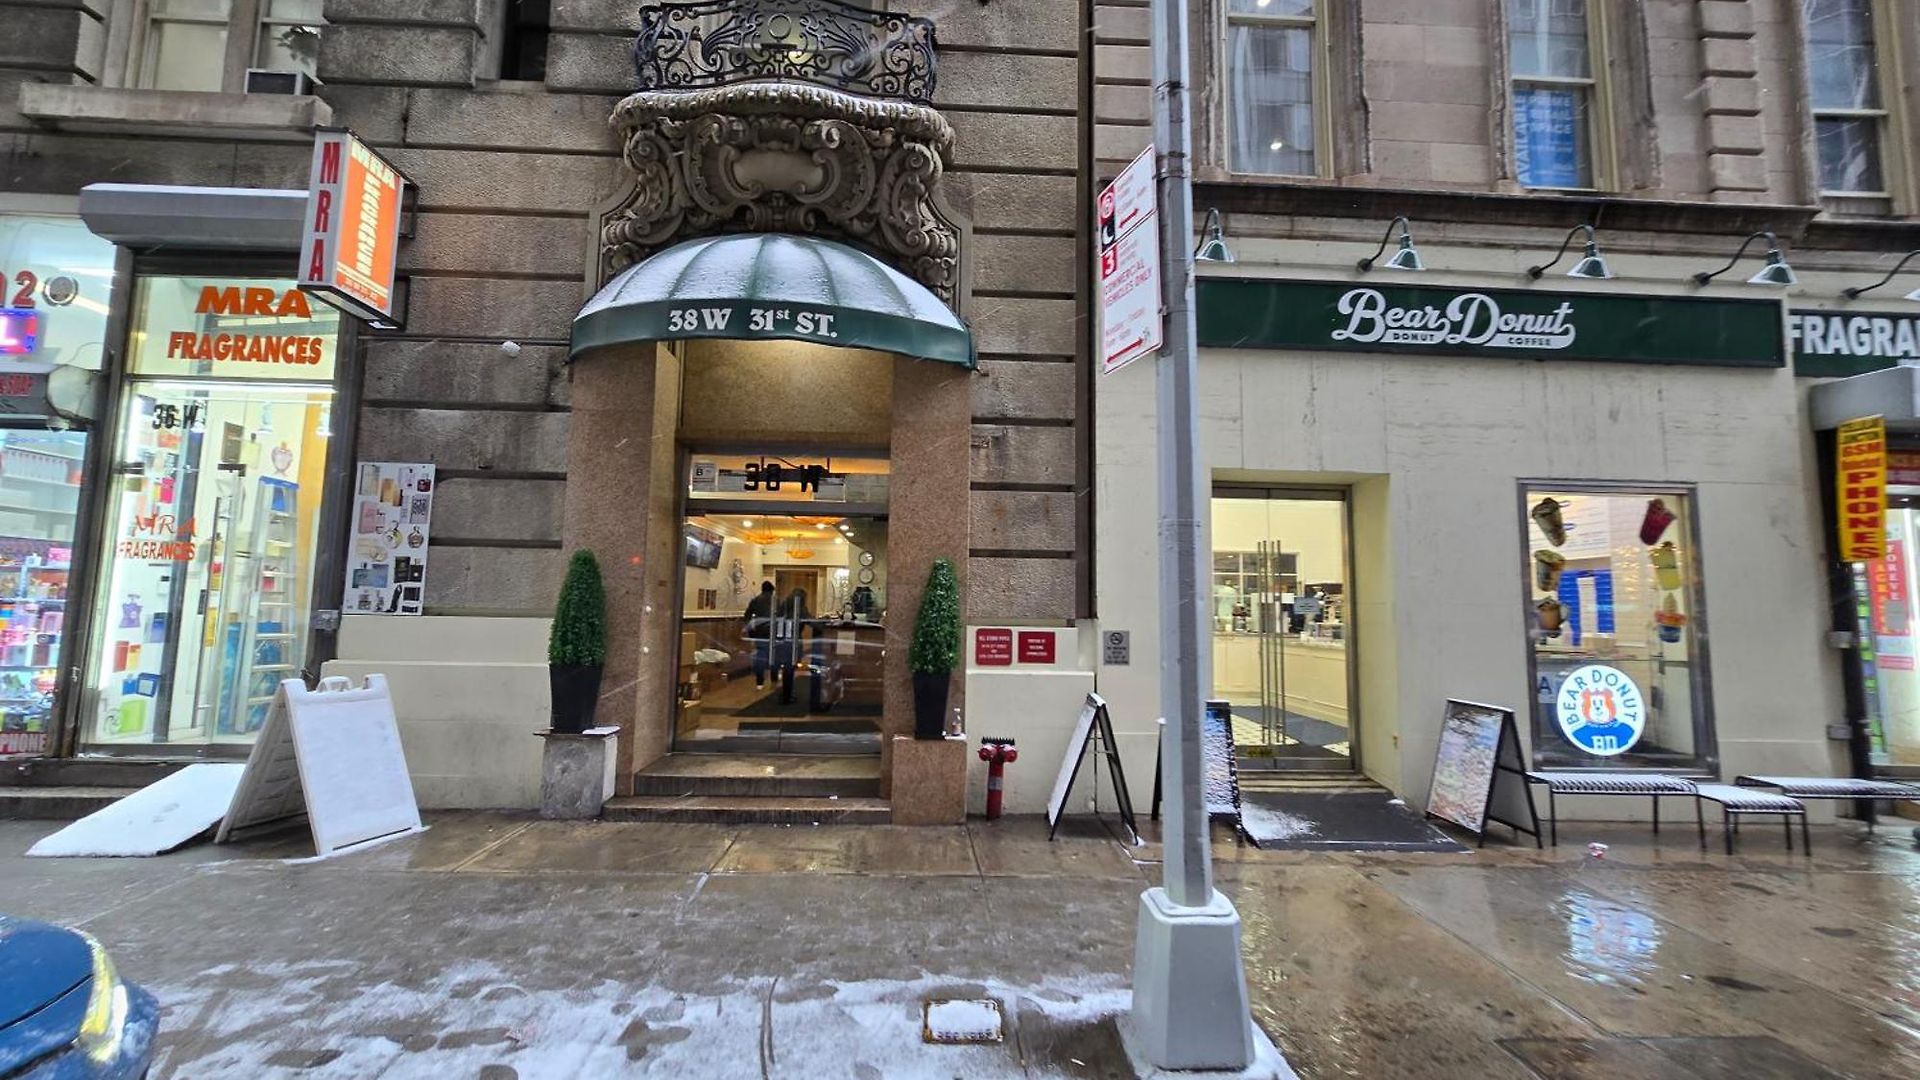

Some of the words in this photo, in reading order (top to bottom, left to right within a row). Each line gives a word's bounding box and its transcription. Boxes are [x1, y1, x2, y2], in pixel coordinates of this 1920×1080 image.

[308, 142, 340, 281] MRA
[1104, 249, 1114, 275] 3
[195, 286, 311, 318] MRA
[795, 311, 838, 338] ST.
[1331, 288, 1450, 343] Bear
[1446, 293, 1576, 349] Donut
[167, 331, 323, 364] FRAGRANCES
[1393, 333, 1435, 341] DONUT
[1507, 337, 1550, 346] COFFEE
[1846, 472, 1880, 559] PHONES
[1537, 676, 1552, 694] A
[1563, 676, 1588, 725] BEAR
[1592, 670, 1637, 722] DONUT
